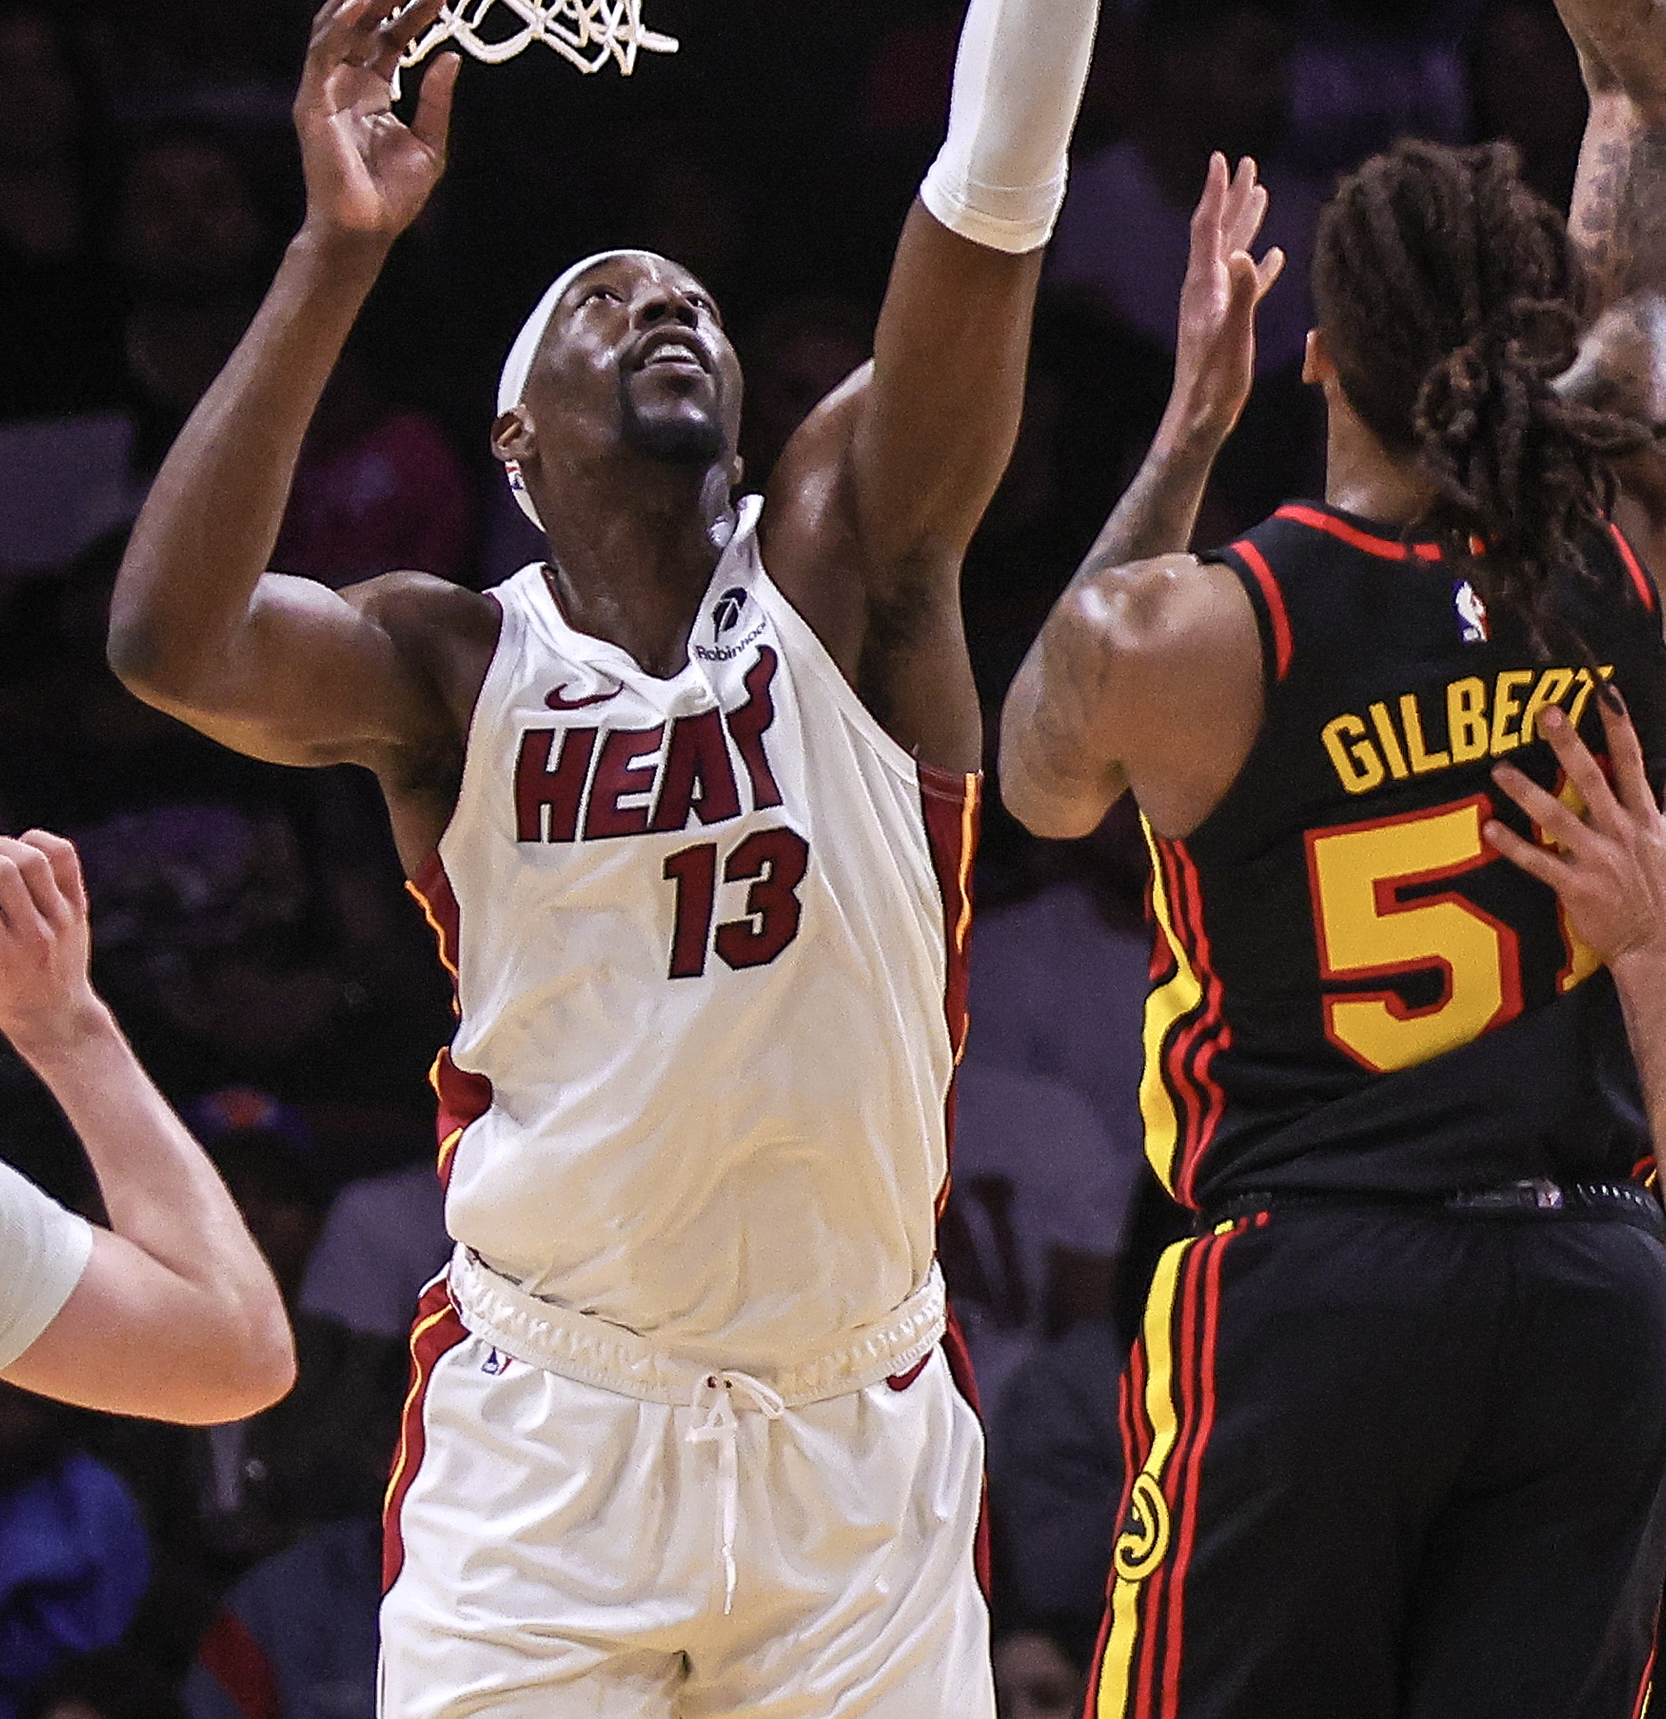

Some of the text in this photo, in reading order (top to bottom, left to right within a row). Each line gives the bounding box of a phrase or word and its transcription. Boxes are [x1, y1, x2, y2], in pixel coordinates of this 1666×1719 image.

[695, 621, 766, 661] Robinhoo
[513, 644, 783, 843] HEAT
[662, 825, 810, 981] 13
[1303, 754, 1610, 1074] 5
